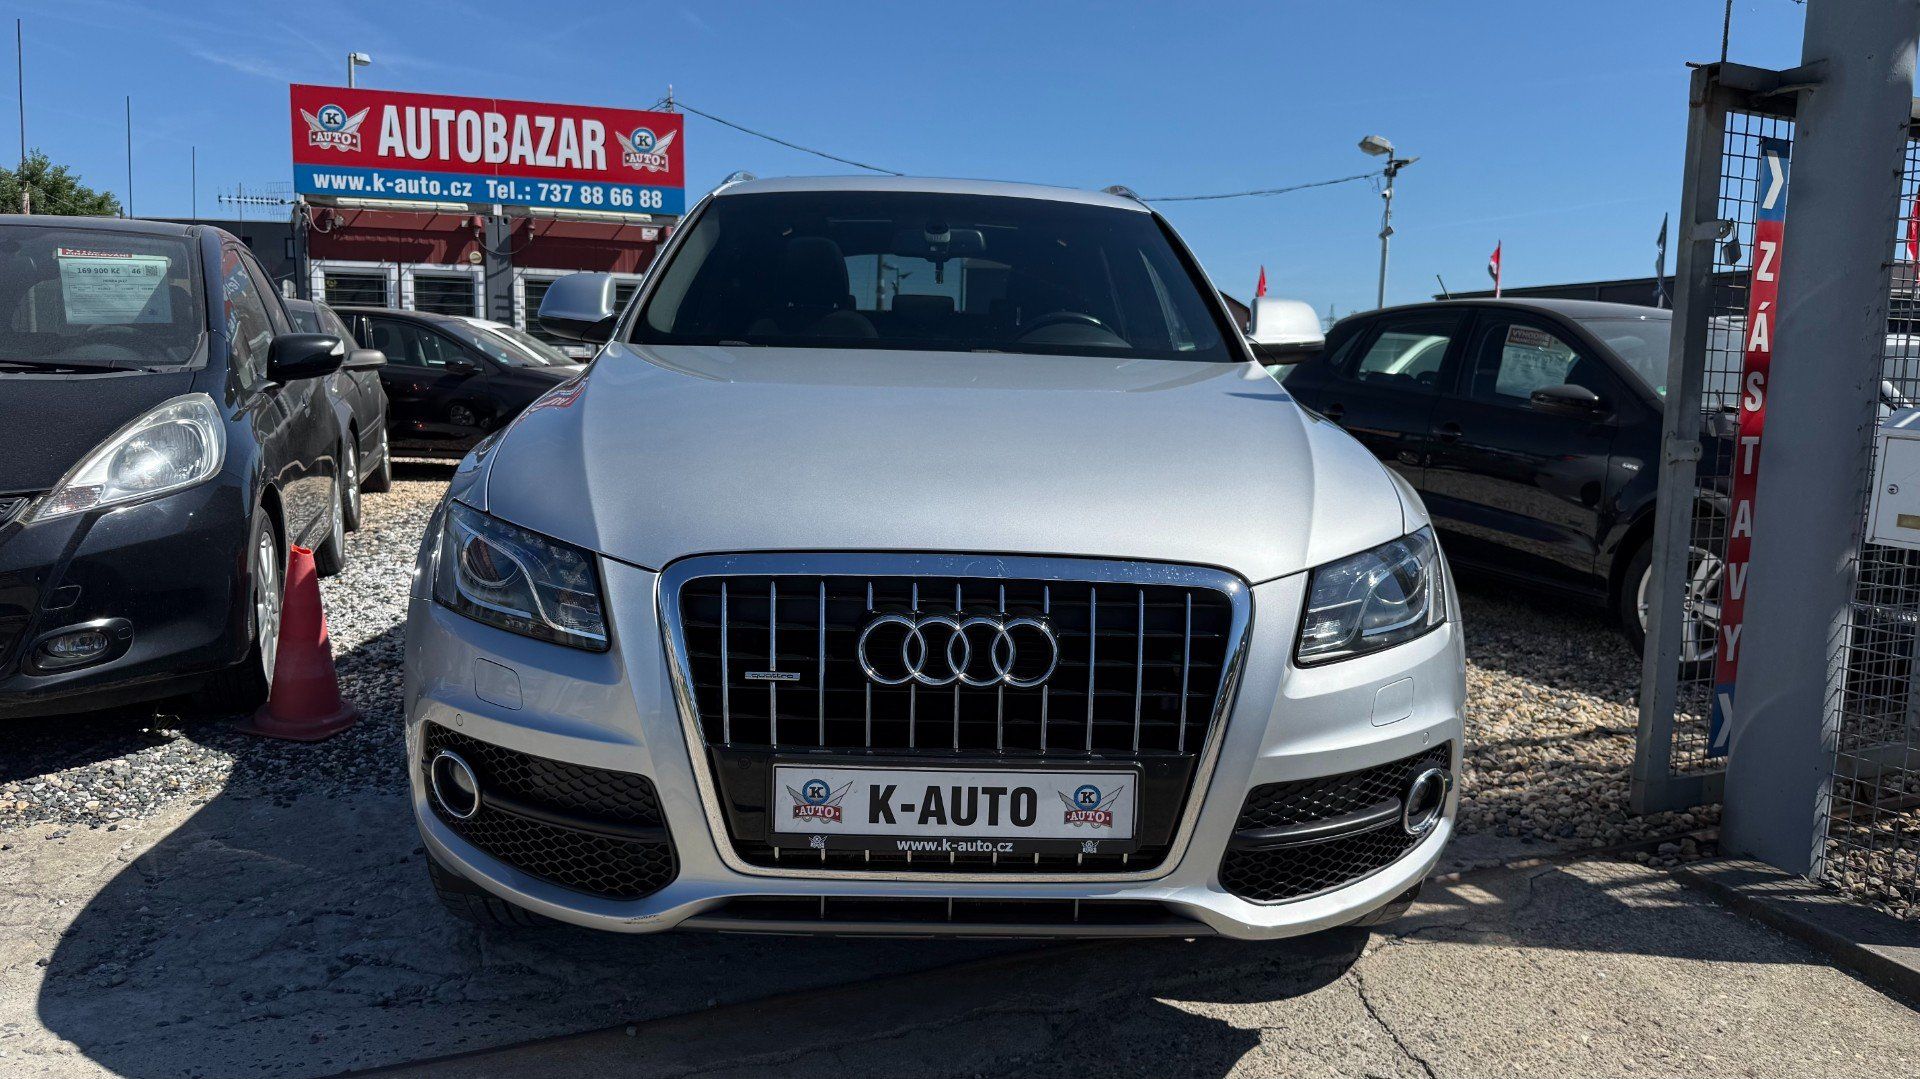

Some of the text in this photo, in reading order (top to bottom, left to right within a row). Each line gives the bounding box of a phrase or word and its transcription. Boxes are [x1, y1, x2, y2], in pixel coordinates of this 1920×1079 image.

[324, 112, 340, 125] K
[315, 131, 352, 145] AUTO
[377, 104, 608, 171] AUTOBAZAR
[636, 134, 651, 147] K
[628, 153, 661, 166] AUTO
[312, 172, 663, 209] www.k-auto.cz Tel.: 737 88 66 88
[77, 266, 92, 275] 169
[93, 266, 109, 275] 900
[131, 267, 142, 275] 46
[1723, 240, 1777, 663] ZÁSTAVY
[808, 786, 824, 799] K
[1080, 791, 1095, 804] K
[799, 805, 835, 818] AUTO
[868, 784, 1038, 828] K-AUTO
[1069, 811, 1105, 823] AUTO
[896, 838, 1014, 853] www.k-auto.cz
